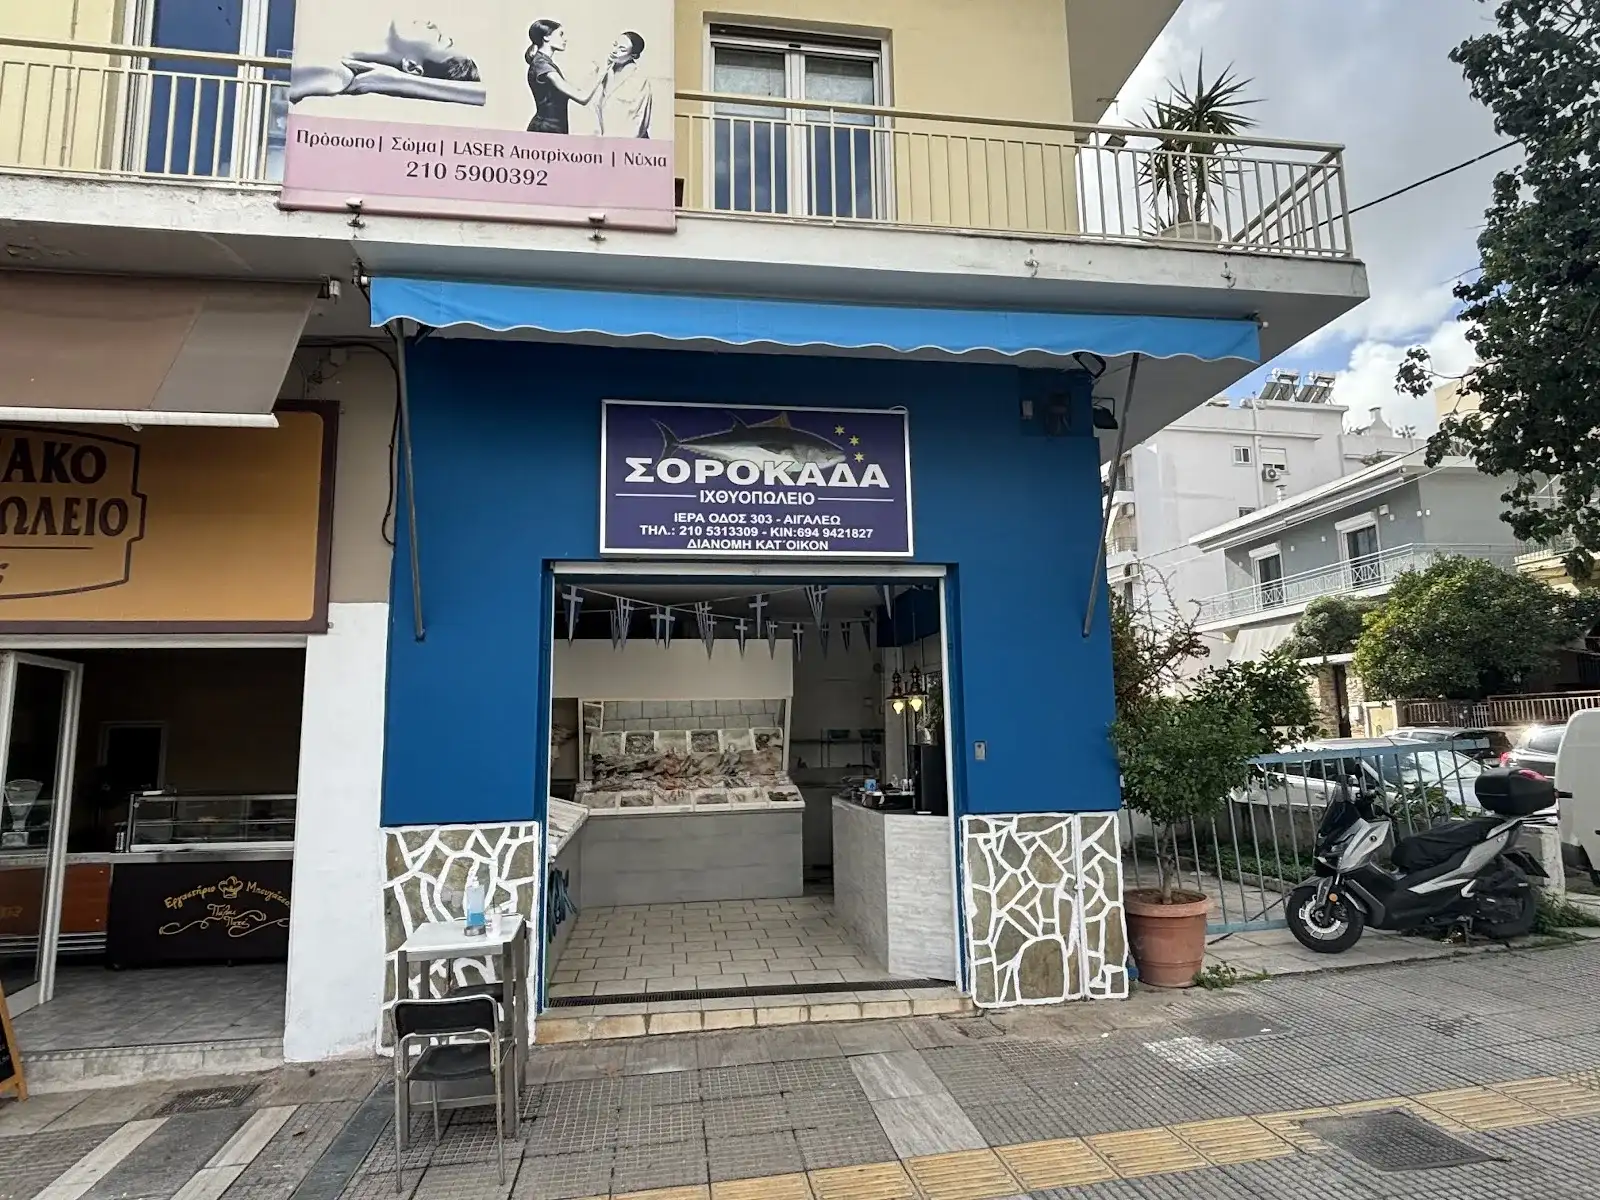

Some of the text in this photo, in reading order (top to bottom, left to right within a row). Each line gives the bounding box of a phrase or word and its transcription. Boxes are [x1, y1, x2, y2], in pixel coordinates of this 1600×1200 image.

[453, 140, 505, 158] LASER
[509, 145, 603, 165] Αποτρίχωση
[624, 151, 667, 167] Νύχια
[406, 161, 548, 187] 210 5900392
[0, 437, 107, 484] ΑΚΟ
[624, 457, 890, 489] ΣΟΡΟΚΑΔΑ
[699, 489, 815, 505] ΙΧΘΥΟΠΩΛΕΙΟ
[674, 512, 706, 523] ΙΕΡΑ
[708, 513, 747, 524] ΟΔΟΣ
[750, 514, 773, 524] 303
[783, 515, 841, 525] ΑΙΓΑΛΕΩ
[639, 525, 676, 536] ΤΗΛ.:
[679, 526, 703, 536] 210
[706, 526, 759, 537] 5313309
[822, 528, 874, 539] 9421827
[686, 539, 752, 549] ΔΙΑΝΟΜΗ
